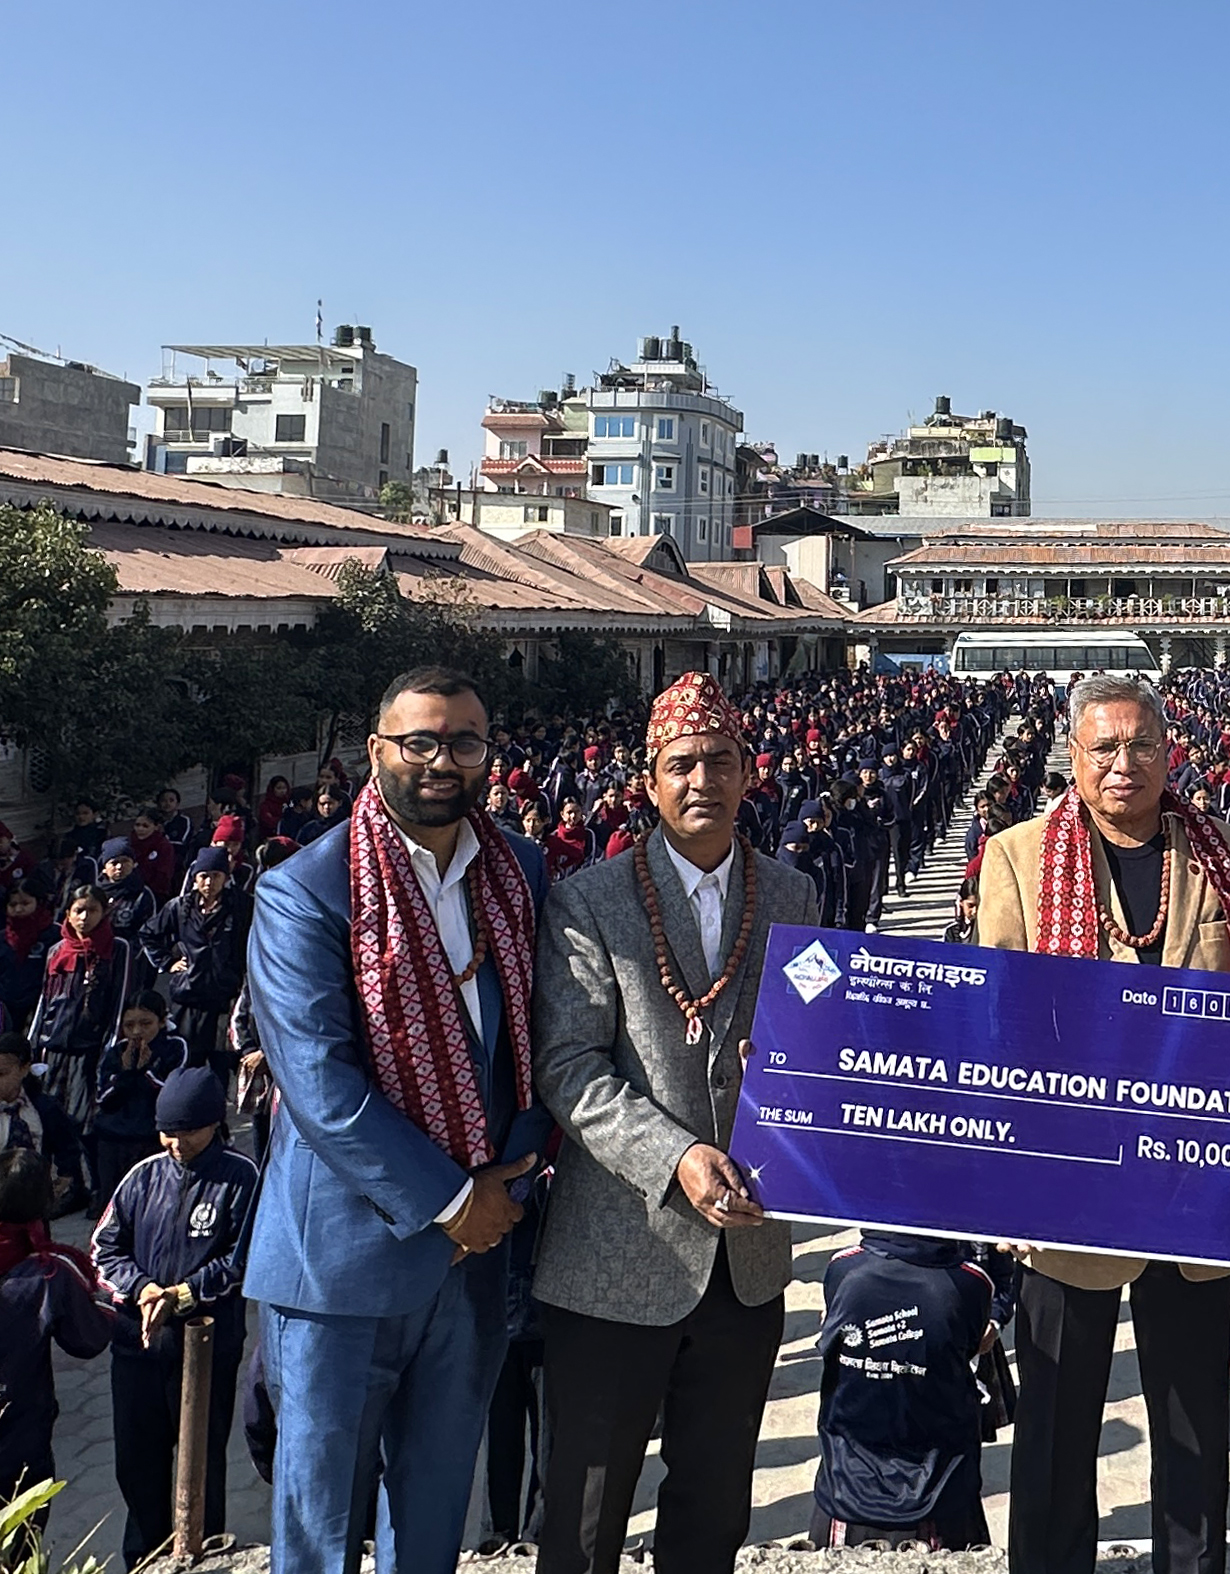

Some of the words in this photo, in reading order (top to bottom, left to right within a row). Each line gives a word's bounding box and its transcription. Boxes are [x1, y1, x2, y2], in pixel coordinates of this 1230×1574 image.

[850, 946, 914, 977] नेपाल
[915, 960, 987, 988] लाइफ
[1122, 989, 1157, 1006] Date
[768, 1051, 787, 1065] TO
[838, 1047, 948, 1082] SAMATA
[958, 1062, 1106, 1100] EDUCATION
[759, 1106, 783, 1121] THE
[784, 1109, 813, 1124] SUM
[841, 1103, 884, 1127] TEN
[886, 1109, 947, 1135] LAKH
[950, 1116, 1016, 1143] ONLY.
[1137, 1135, 1171, 1161] Rs.
[894, 1305, 919, 1320] School
[898, 1329, 923, 1340] College
